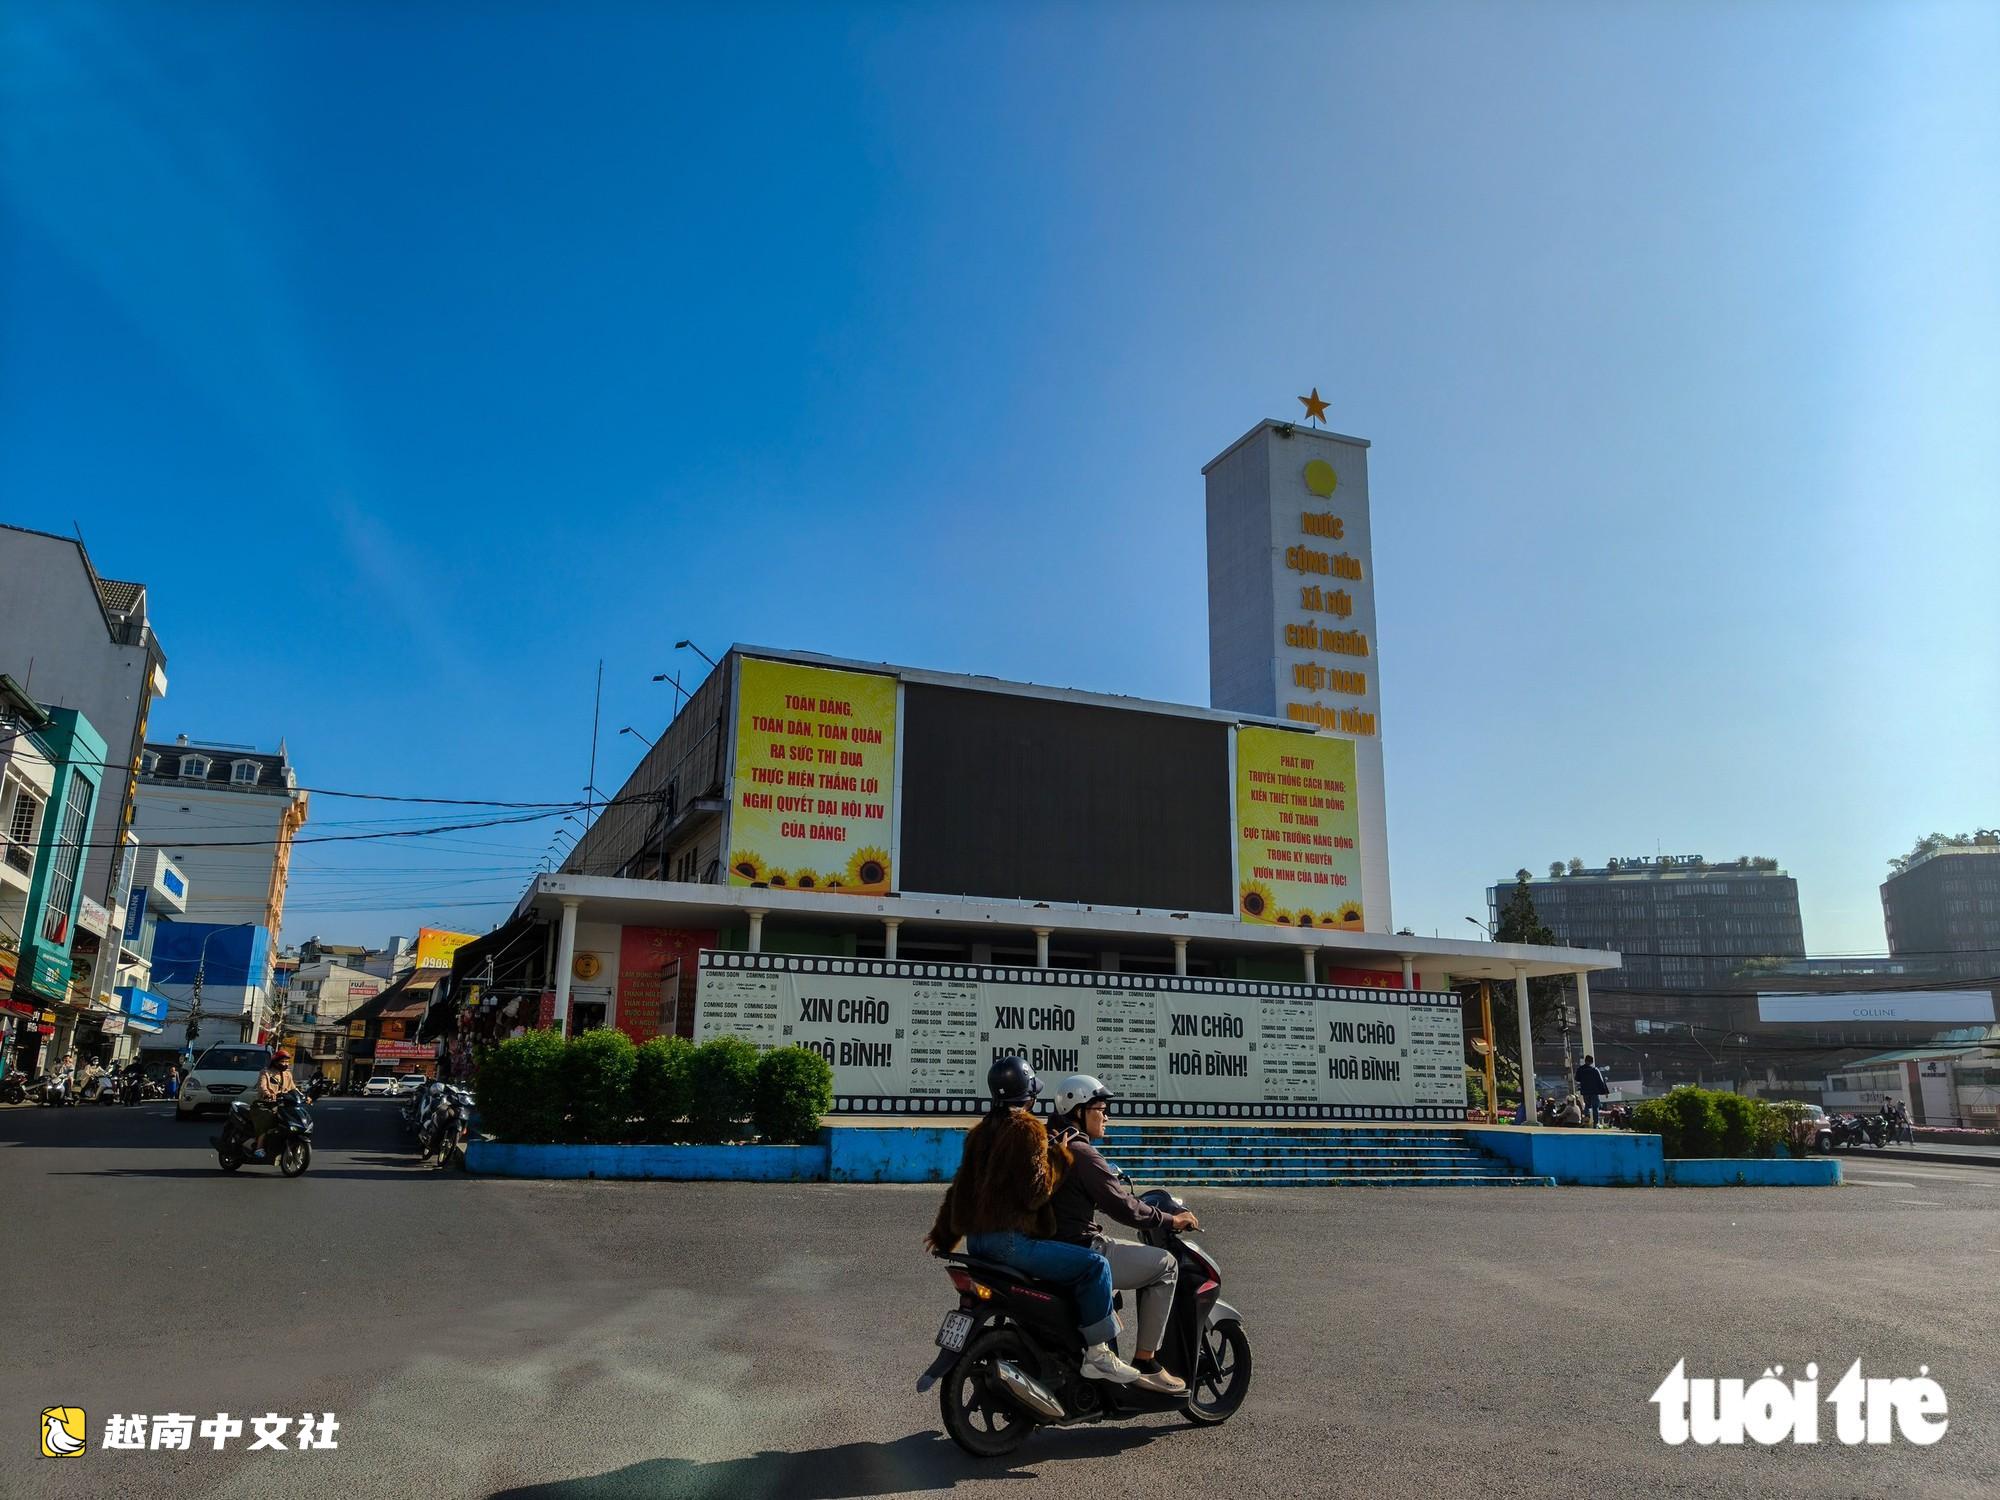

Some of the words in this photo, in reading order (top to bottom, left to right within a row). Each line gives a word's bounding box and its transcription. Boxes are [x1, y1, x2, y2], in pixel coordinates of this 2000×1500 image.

[1301, 510, 1344, 540] NƯỚC
[1286, 545, 1330, 576] CỘNG
[1331, 552, 1363, 581] HÒA
[1301, 585, 1323, 612] XÃ
[1326, 589, 1352, 620] HỘI
[1285, 619, 1318, 650] CHỦ
[1321, 629, 1369, 657] NGHĨA
[1293, 661, 1326, 692] VIỆT
[1330, 668, 1367, 696] NAM
[785, 694, 815, 712] TOÀN
[819, 697, 853, 717] ĐẢNG,
[752, 716, 783, 733] TOÀN
[787, 722, 814, 738] DÂN,
[818, 723, 848, 740] TOÀN
[851, 727, 882, 744] QUÂN
[1340, 706, 1376, 735] NĂM
[770, 744, 786, 759] RA
[790, 745, 814, 762] SỨC
[818, 749, 837, 764] THI
[840, 751, 863, 767] ĐUA
[1301, 758, 1315, 770] HUY
[751, 767, 784, 787] THỰC
[787, 771, 815, 789] HIỆN
[819, 771, 857, 792] THẮNG
[861, 778, 878, 796] LỢI
[1303, 775, 1322, 790] CÁCH
[743, 792, 773, 812] NGHỊ
[777, 793, 814, 813] QUYẾT
[817, 800, 837, 818] ĐẠI
[841, 802, 861, 820] HỘI
[865, 804, 884, 819] XIV
[781, 819, 806, 838] CỦA
[809, 821, 846, 842] ĐẢNG!
[1267, 848, 1291, 861] TRONG
[126, 894, 140, 936] EXIMBANK
[799, 998, 833, 1022] XIN
[837, 996, 889, 1024] CHÀO
[994, 1006, 1024, 1029] XIN
[1028, 1004, 1075, 1031] CHÀO
[1852, 1008, 1896, 1017] COLLINE
[1171, 1014, 1197, 1036] XIN
[1201, 1012, 1243, 1038] CHÀO
[1329, 1021, 1354, 1043] XIN
[1357, 1020, 1395, 1045] CHÀO
[796, 1036, 835, 1066] OÀ
[839, 1037, 892, 1067] BÌNH!
[1032, 1044, 1078, 1072] BÌNH!
[1169, 1049, 1202, 1075] HOÀ
[1205, 1050, 1247, 1077] BÌNH!
[1329, 1055, 1358, 1080] HOÀ
[1361, 1056, 1400, 1081] BÌNH!
